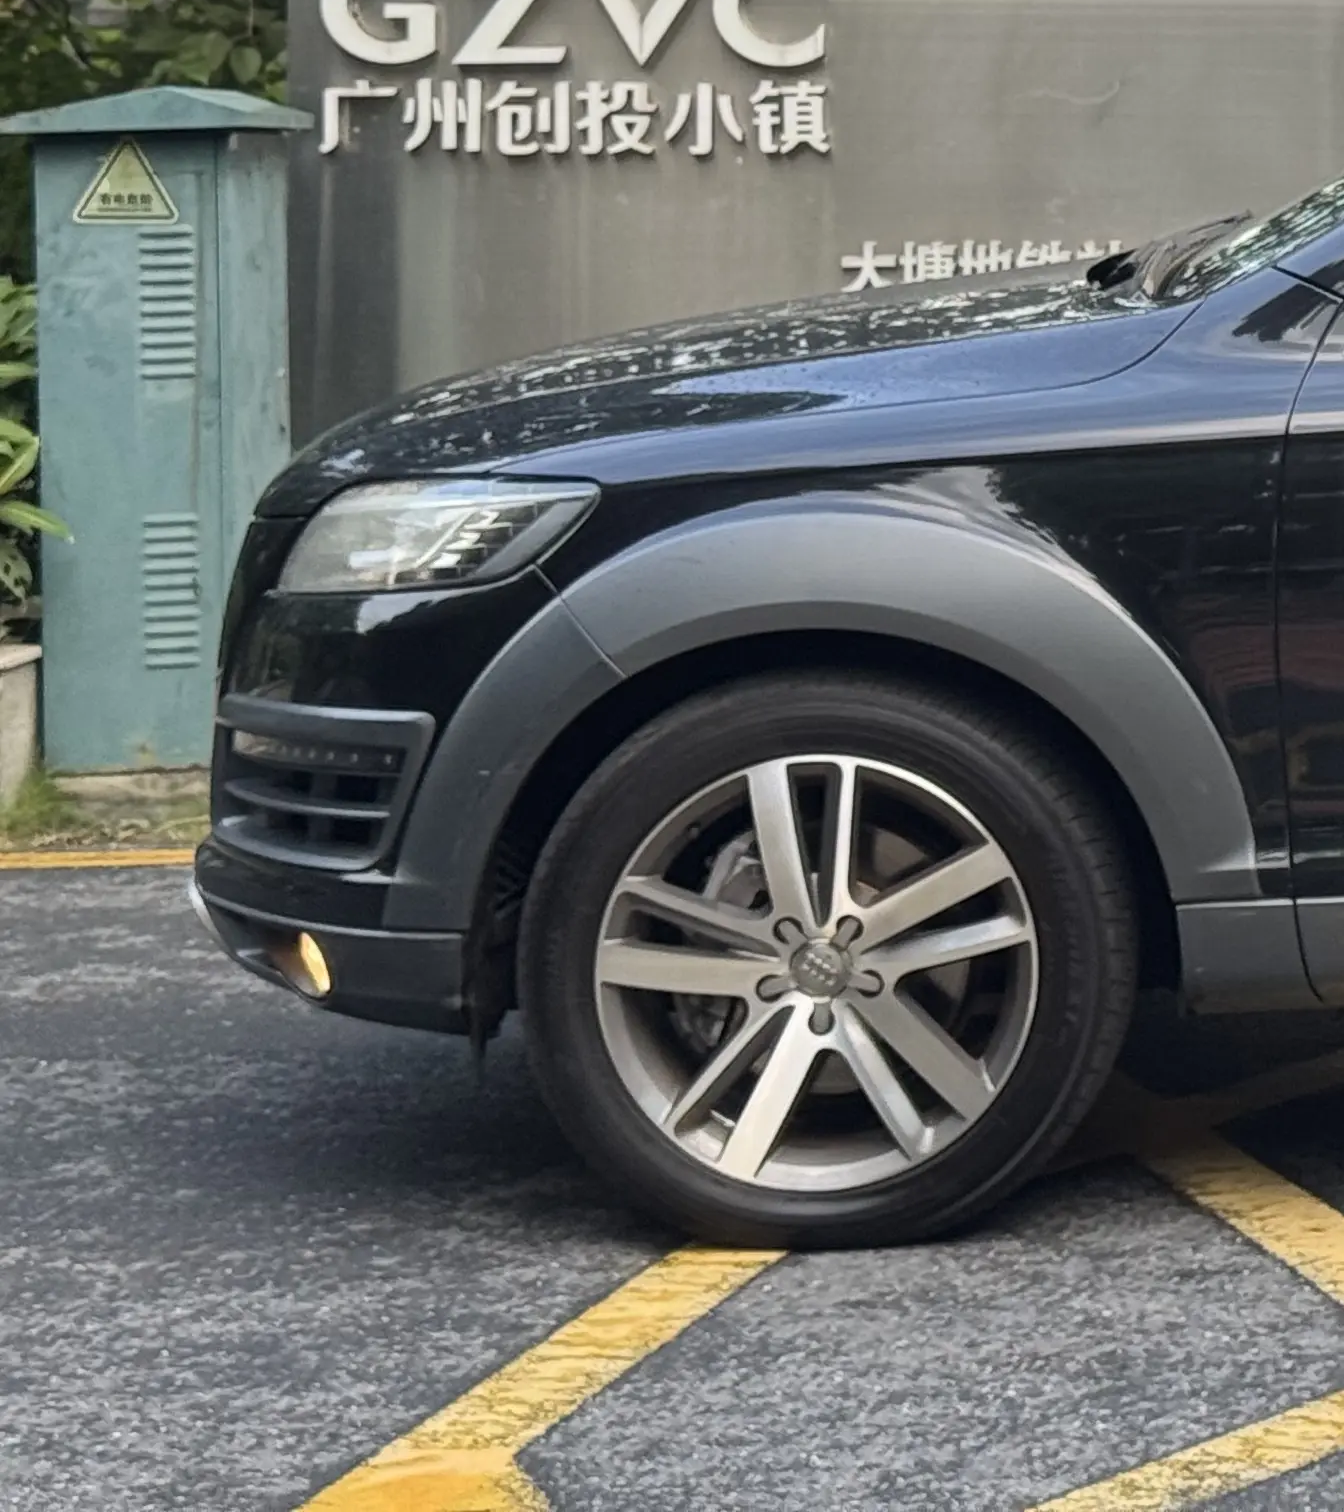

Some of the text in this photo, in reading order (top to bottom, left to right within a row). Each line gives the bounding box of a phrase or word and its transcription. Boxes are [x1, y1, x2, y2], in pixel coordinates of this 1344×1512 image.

[319, 78, 832, 156] 广州创投小镇
